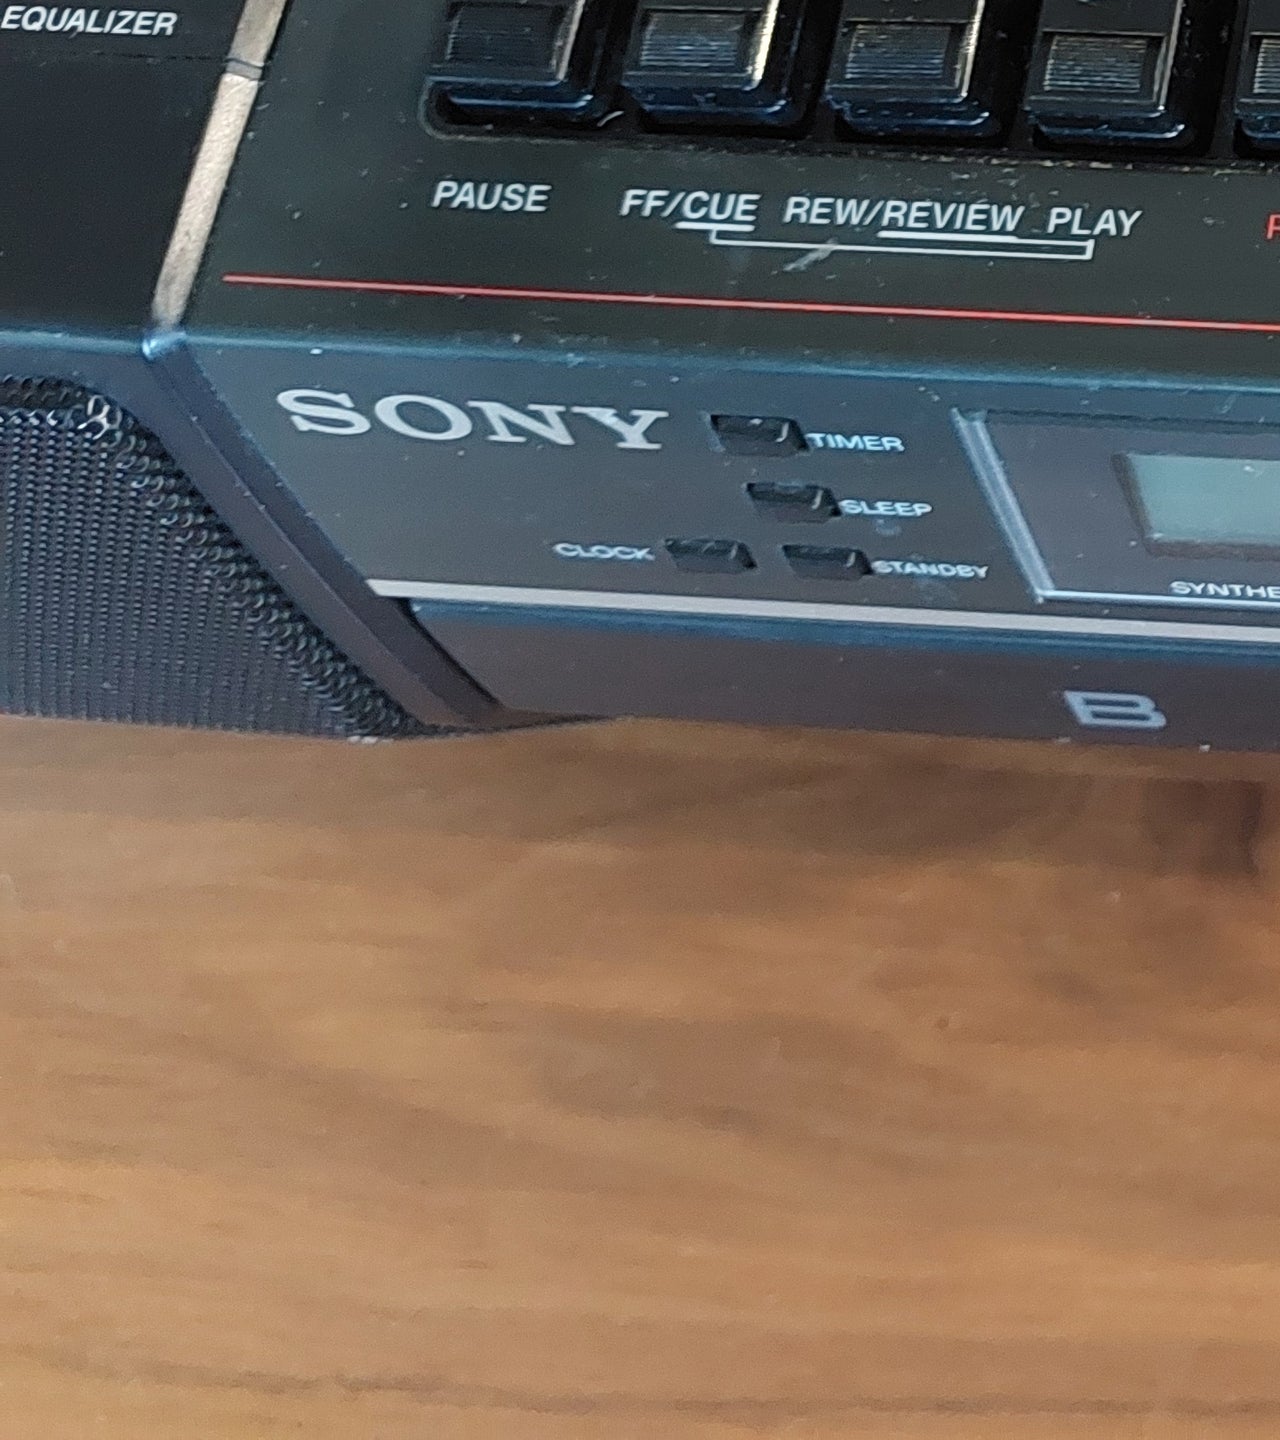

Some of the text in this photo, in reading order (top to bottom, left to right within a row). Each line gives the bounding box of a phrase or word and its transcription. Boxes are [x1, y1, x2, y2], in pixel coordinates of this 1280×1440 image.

[1, 6, 178, 35] EQUALIZER
[432, 181, 551, 211] PAUSE
[620, 189, 761, 221] FF/CUE
[783, 196, 1024, 231] REW/REVIEW
[1046, 207, 1142, 236] PLAY
[277, 389, 669, 450] SONY
[808, 433, 904, 452] TIMER
[842, 499, 932, 517] SLEEP
[553, 542, 655, 560] CLOCK
[871, 560, 989, 578] STANDBY
[1062, 691, 1168, 729] B
